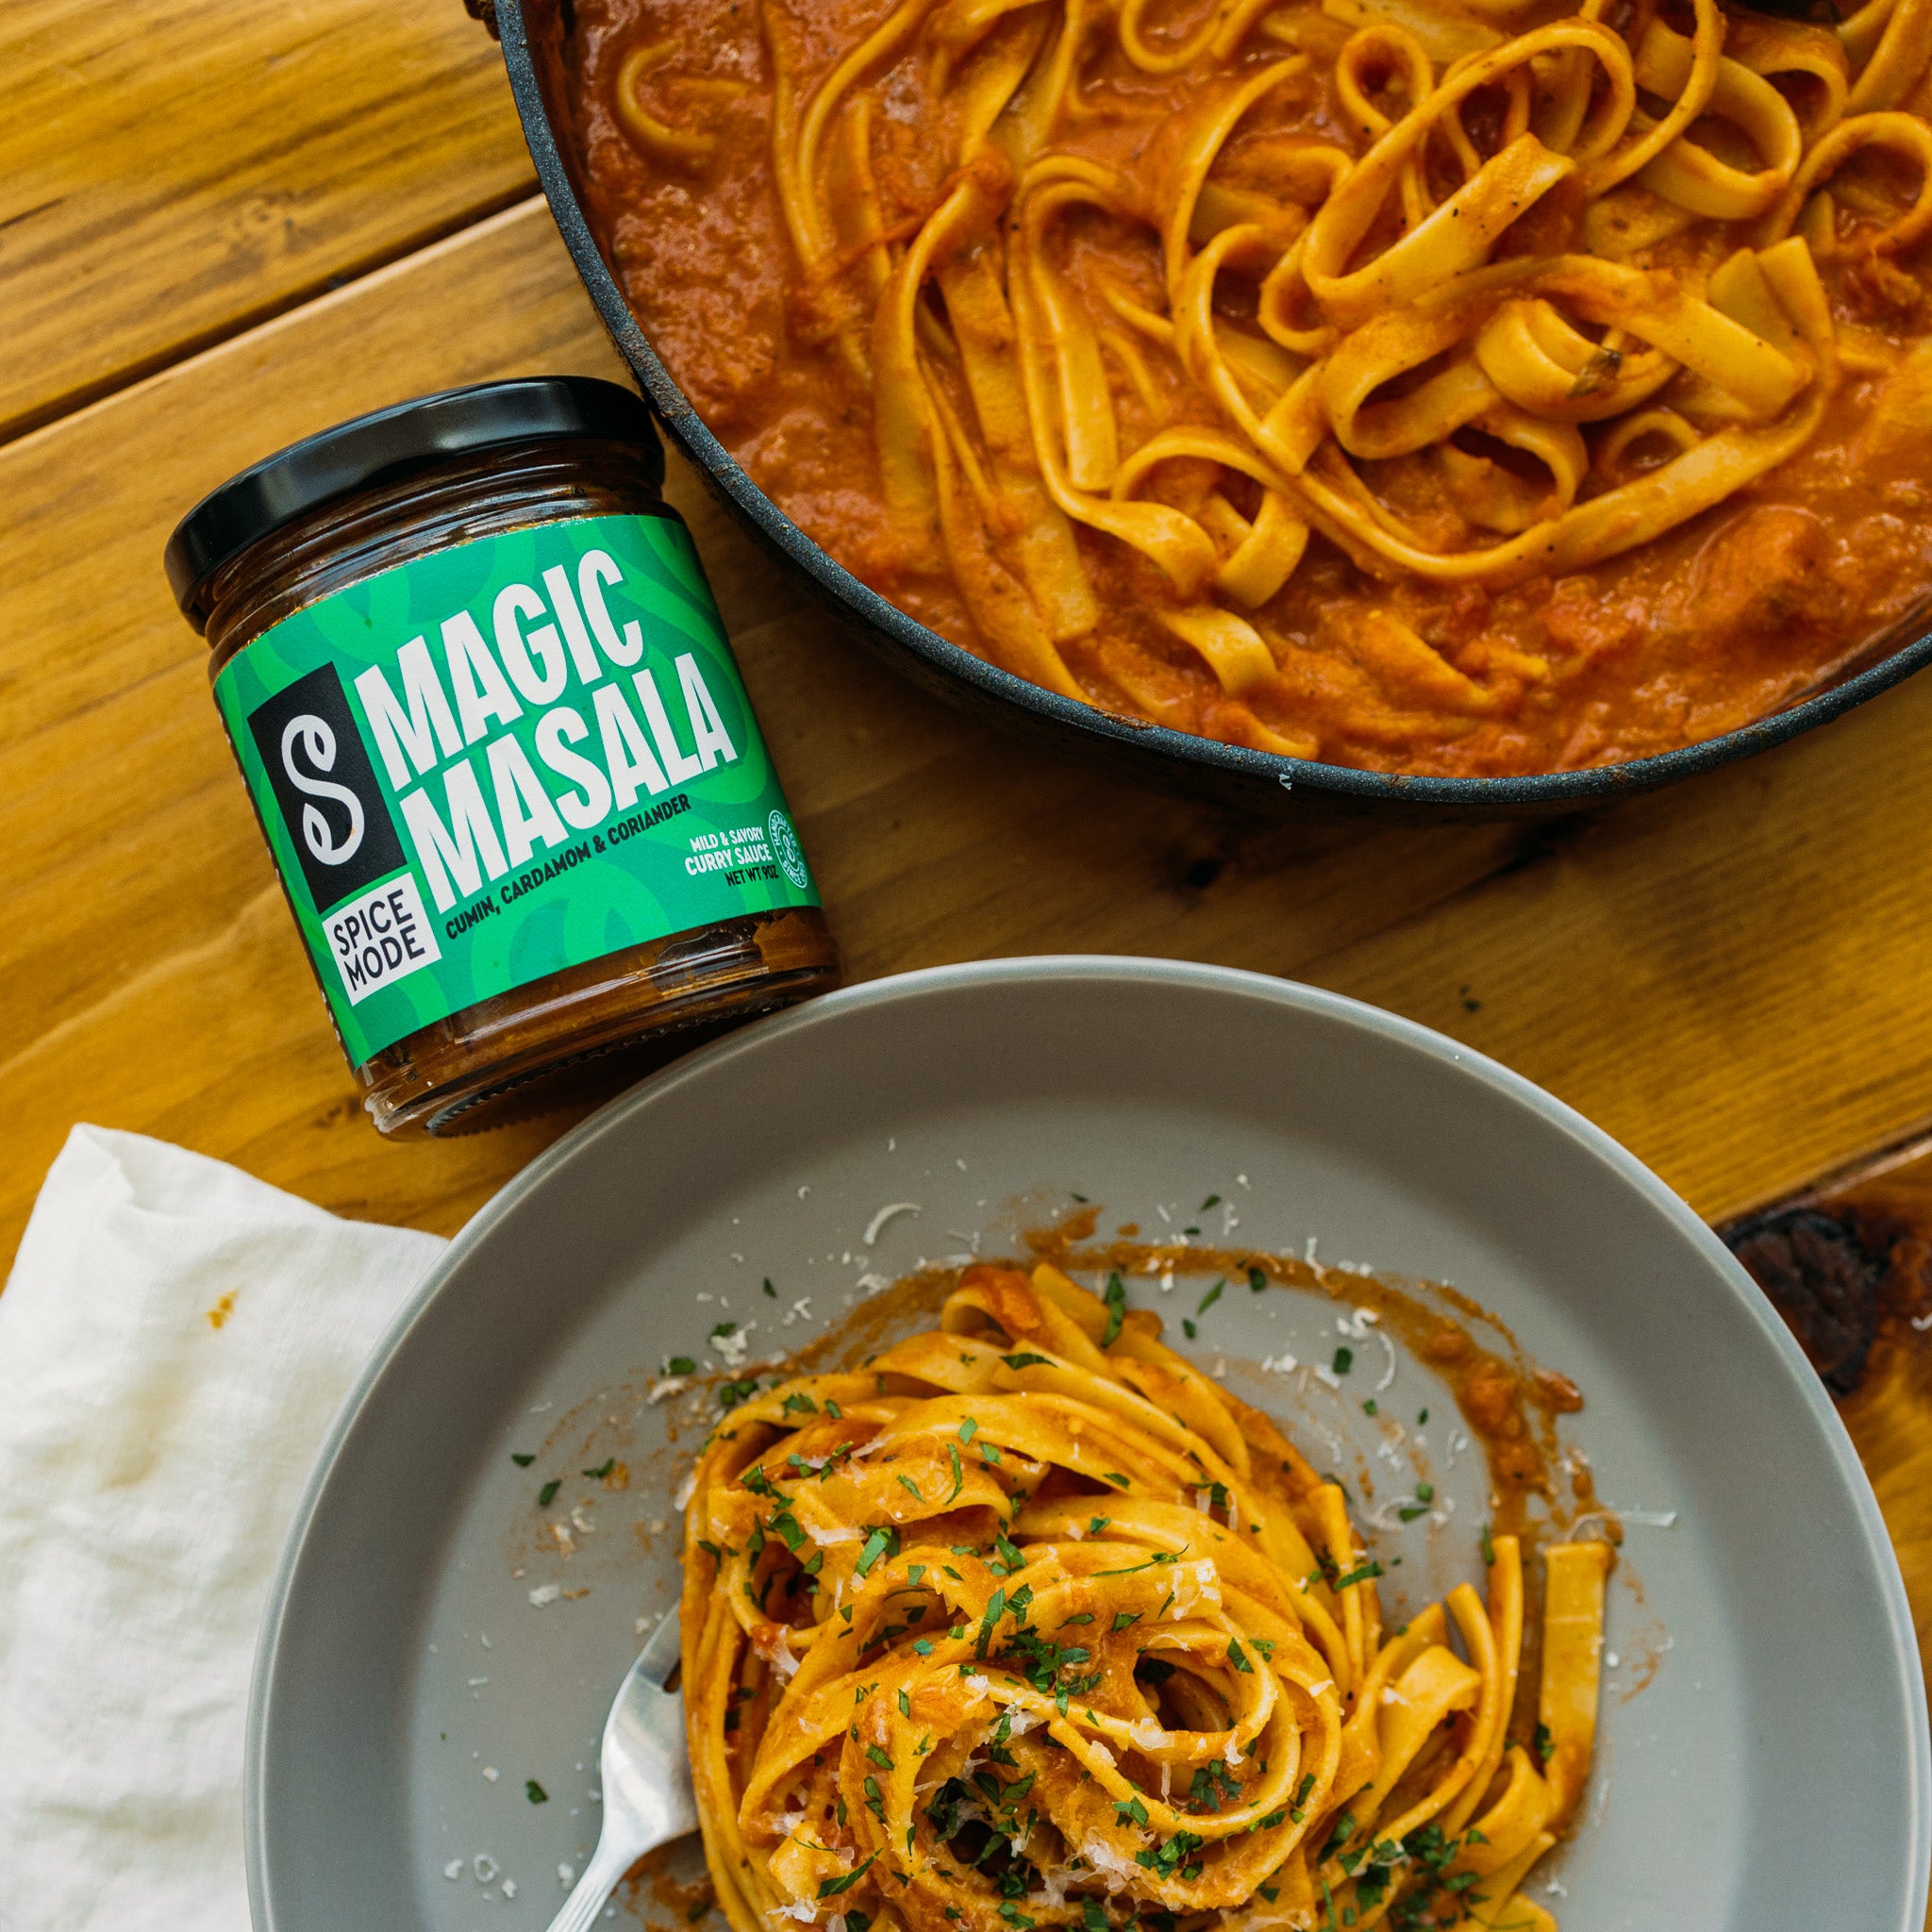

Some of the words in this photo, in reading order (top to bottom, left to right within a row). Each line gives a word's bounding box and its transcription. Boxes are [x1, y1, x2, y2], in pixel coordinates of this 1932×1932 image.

[354, 549, 643, 791] MAGIC
[399, 652, 738, 914] MASALA
[445, 895, 501, 940] CUMIN,
[500, 841, 591, 905] CARDAMOM
[594, 835, 607, 853] &
[607, 793, 691, 845] CORIANDER
[684, 849, 734, 875] CURRY
[735, 843, 773, 865] SAUCE
[689, 833, 718, 853] MILD
[719, 831, 729, 846] &
[731, 826, 765, 844] SAVORY
[724, 870, 746, 887] NET
[745, 866, 761, 882] WT
[333, 889, 413, 956] SPICE
[343, 924, 425, 991] MODE
